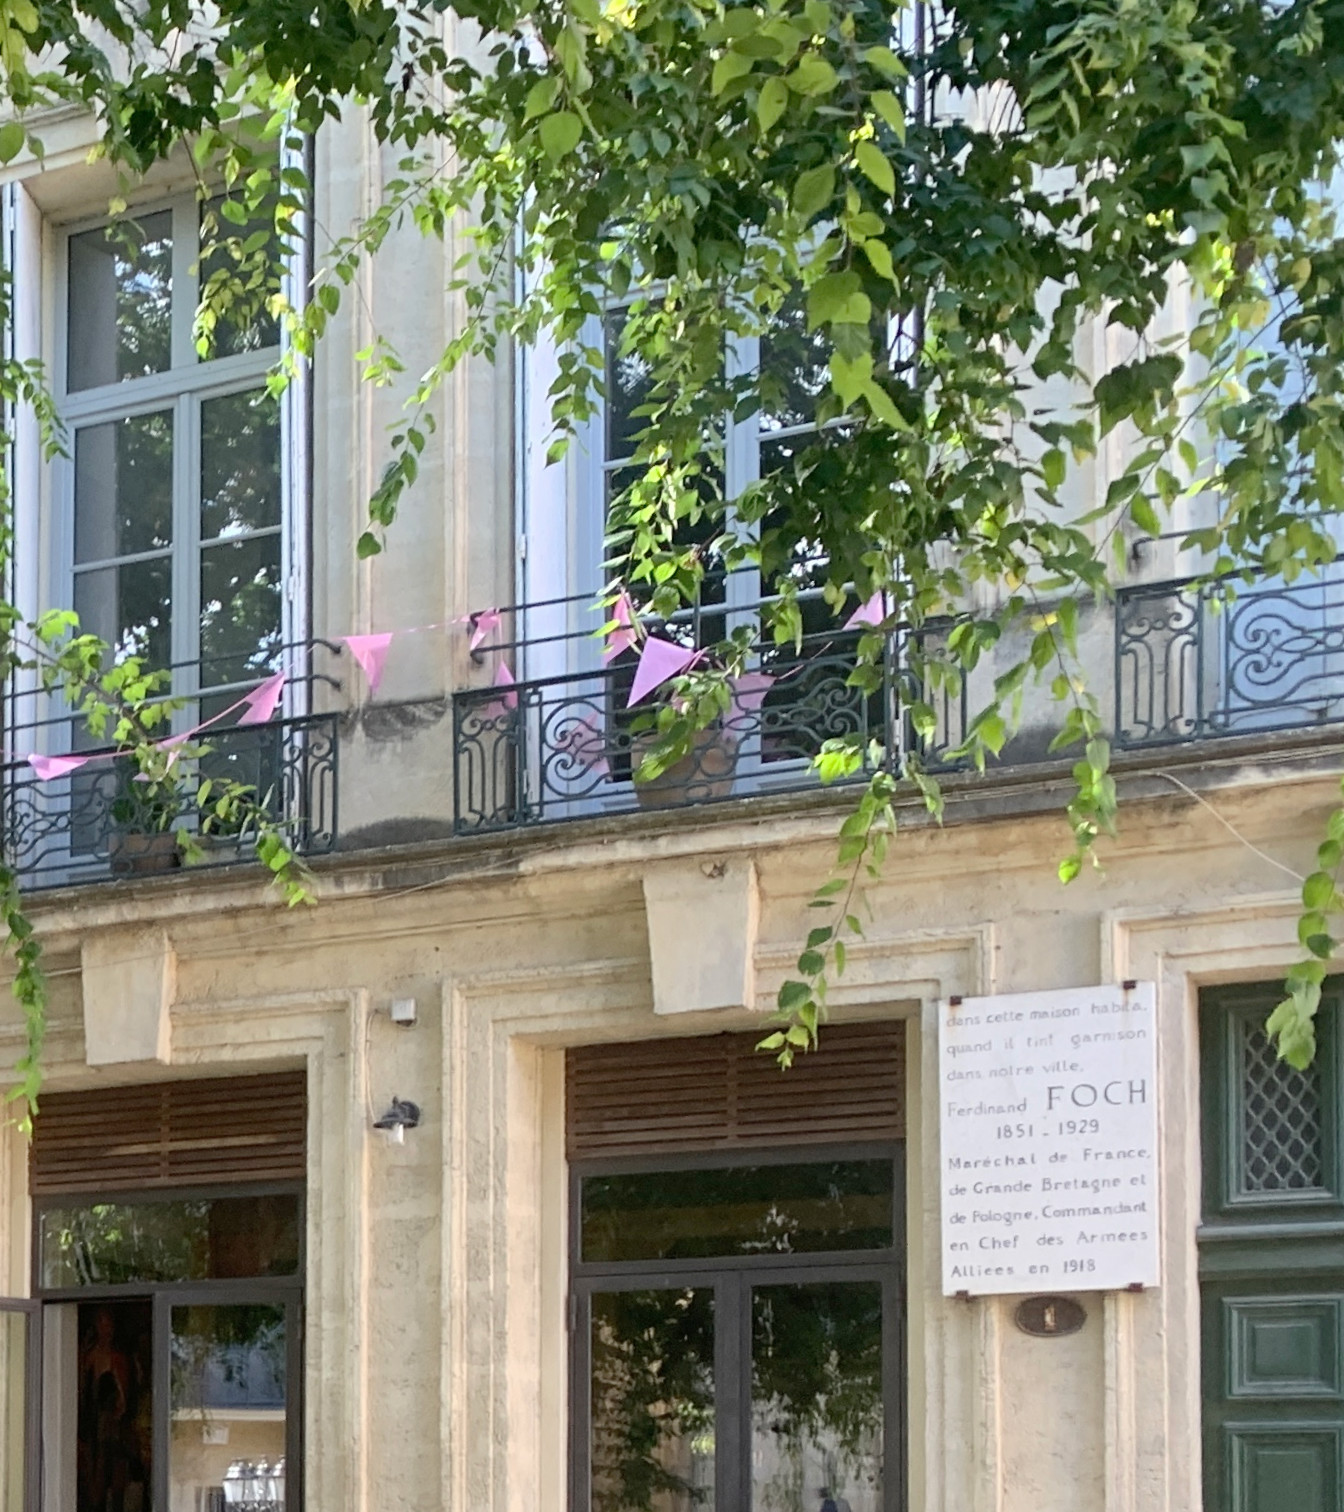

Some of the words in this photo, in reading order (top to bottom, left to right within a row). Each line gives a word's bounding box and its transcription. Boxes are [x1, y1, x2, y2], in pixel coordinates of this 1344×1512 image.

[946, 1014, 981, 1028] dans
[1029, 1006, 1080, 1021] maison
[946, 1040, 992, 1058] quand
[1004, 1037, 1014, 1050] il
[1027, 1034, 1054, 1048] tint
[1070, 1028, 1147, 1049] garnison
[946, 1069, 982, 1082] dans
[947, 1097, 1027, 1118] Ferdinand
[1046, 1078, 1147, 1111] FOCH
[996, 1123, 1034, 1140] 1851
[1058, 1118, 1100, 1136] 1929
[948, 1153, 1037, 1170] Maréchal
[1048, 1151, 1068, 1164] de
[948, 1184, 968, 1197] de
[972, 1177, 1032, 1195] Grande
[1041, 1176, 1121, 1194] Bretagne
[949, 1212, 967, 1225] de
[1041, 1201, 1147, 1219] Commandant
[949, 1240, 969, 1252] en
[978, 1234, 1020, 1250] Chef
[1036, 1233, 1064, 1247] des
[1028, 1262, 1050, 1275] en
[1063, 1258, 1097, 1275] 1918
